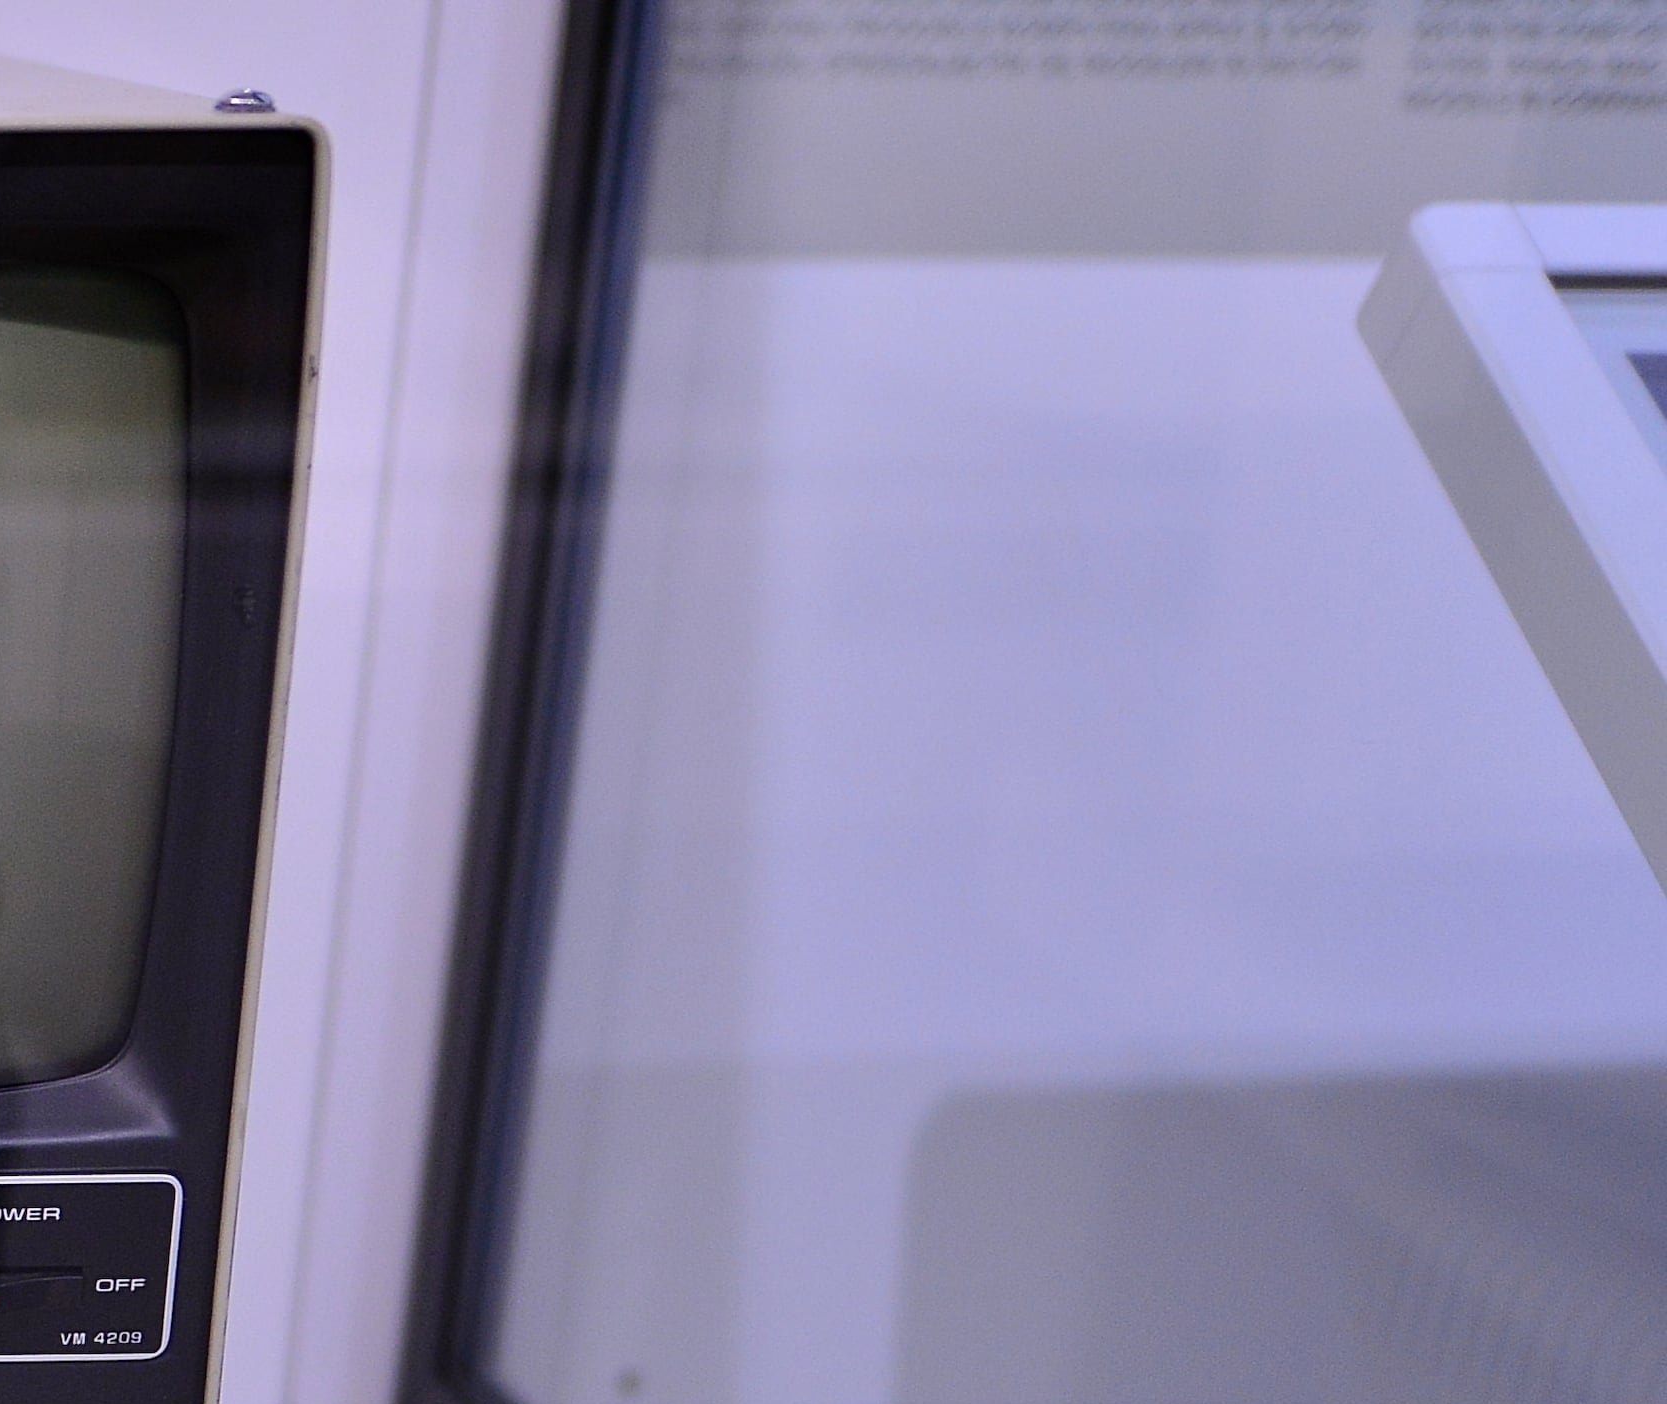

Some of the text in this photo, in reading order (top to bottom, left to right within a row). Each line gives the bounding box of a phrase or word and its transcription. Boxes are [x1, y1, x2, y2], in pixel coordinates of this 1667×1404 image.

[95, 1278, 146, 1293] OFF
[60, 1330, 143, 1346] VM 4209
